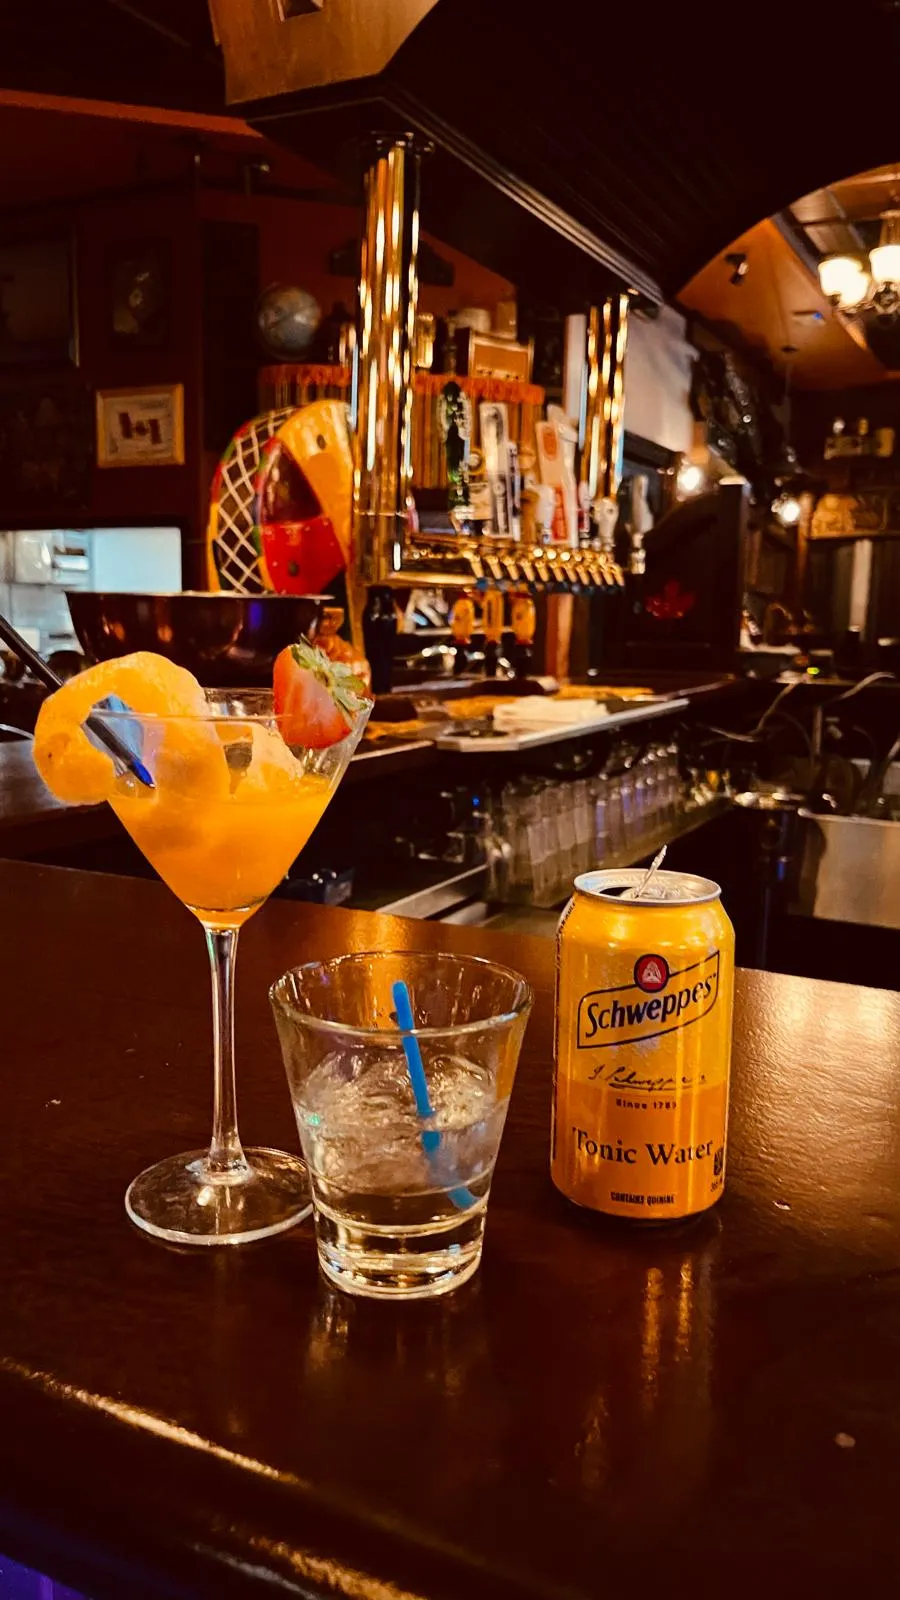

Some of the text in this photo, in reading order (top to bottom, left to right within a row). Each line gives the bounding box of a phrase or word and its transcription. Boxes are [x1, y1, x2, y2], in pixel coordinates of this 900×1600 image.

[585, 978, 712, 1038] Schweppes
[615, 1097, 648, 1110] Since
[571, 1126, 638, 1164] Tonic
[644, 1139, 714, 1166] Water
